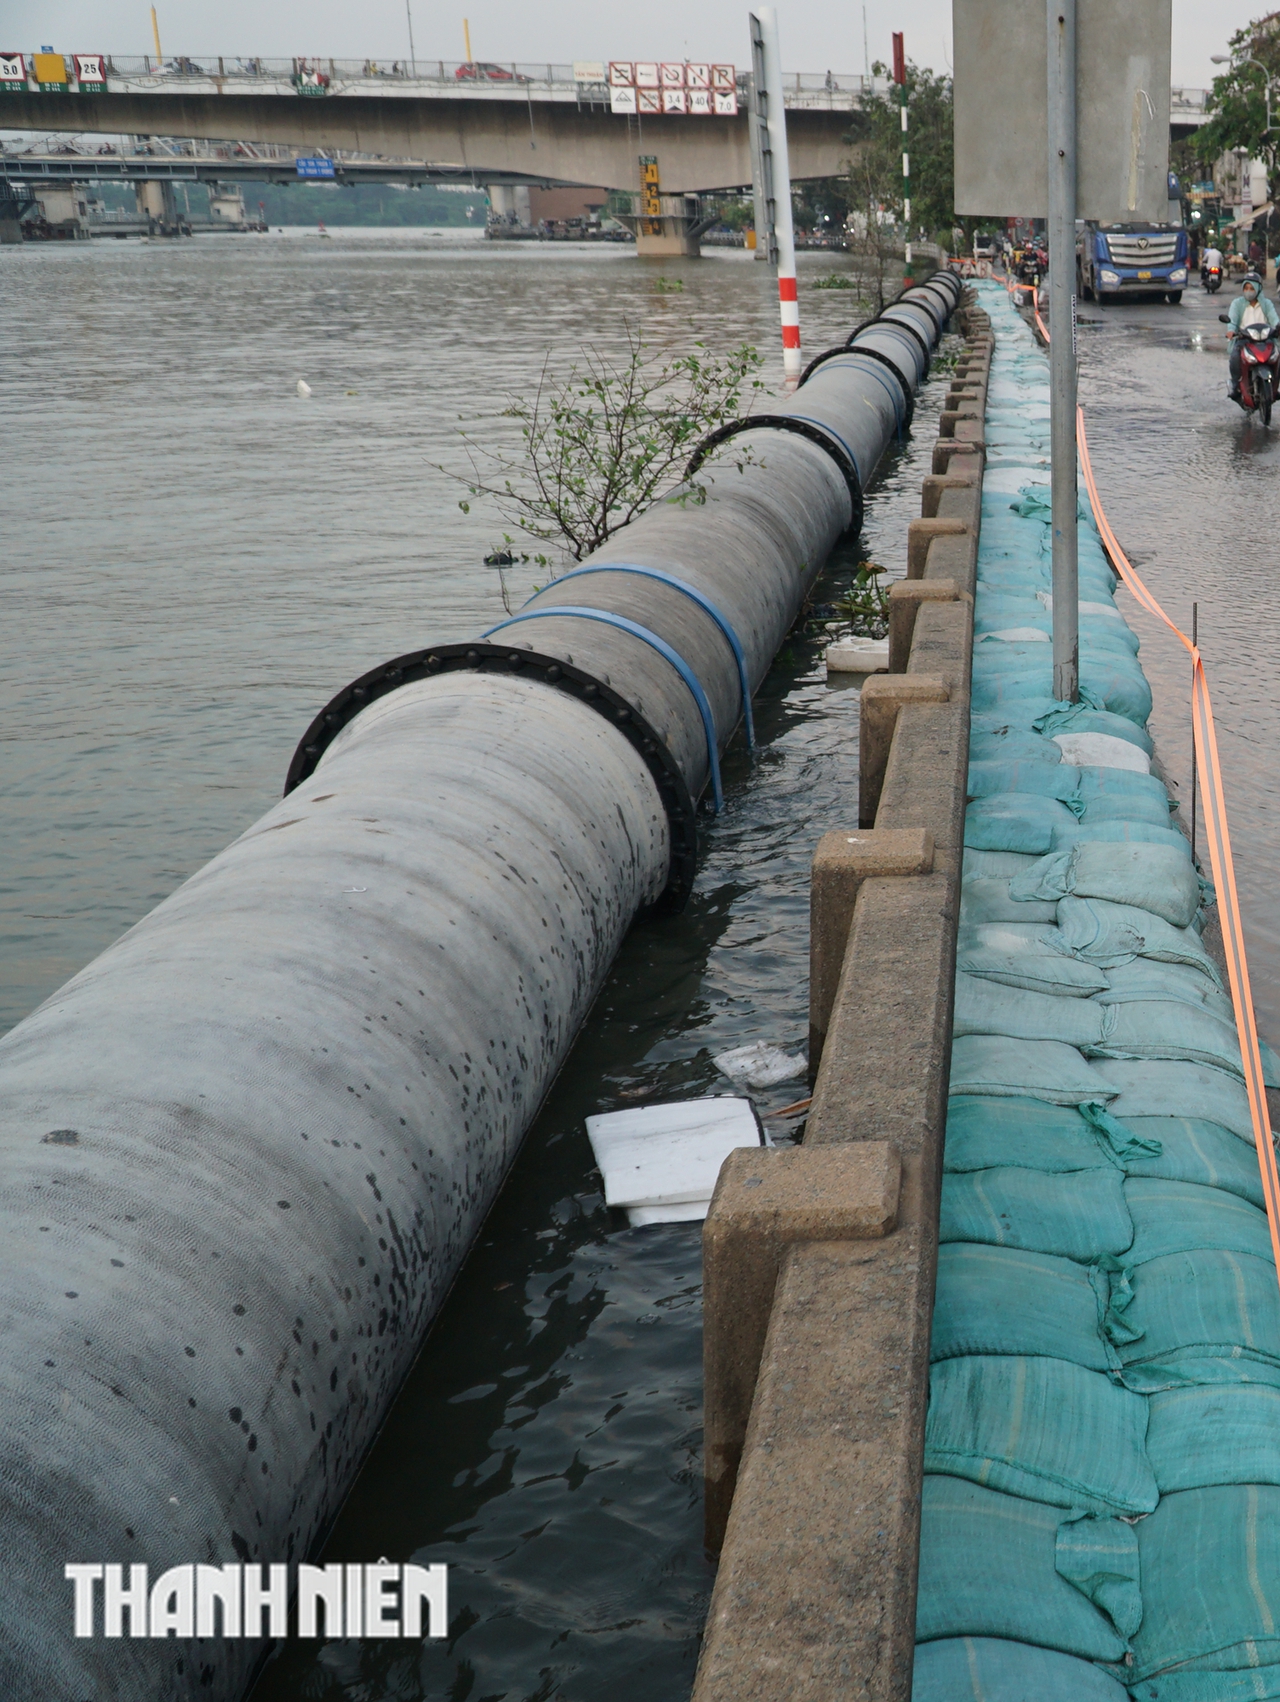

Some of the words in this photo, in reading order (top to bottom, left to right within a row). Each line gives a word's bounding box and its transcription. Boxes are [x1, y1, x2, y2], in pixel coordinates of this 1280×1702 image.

[3, 65, 18, 75] 5.0
[84, 64, 97, 74] 25
[668, 94, 681, 104] 3.4
[694, 97, 704, 106] 40
[719, 101, 732, 111] 7.0
